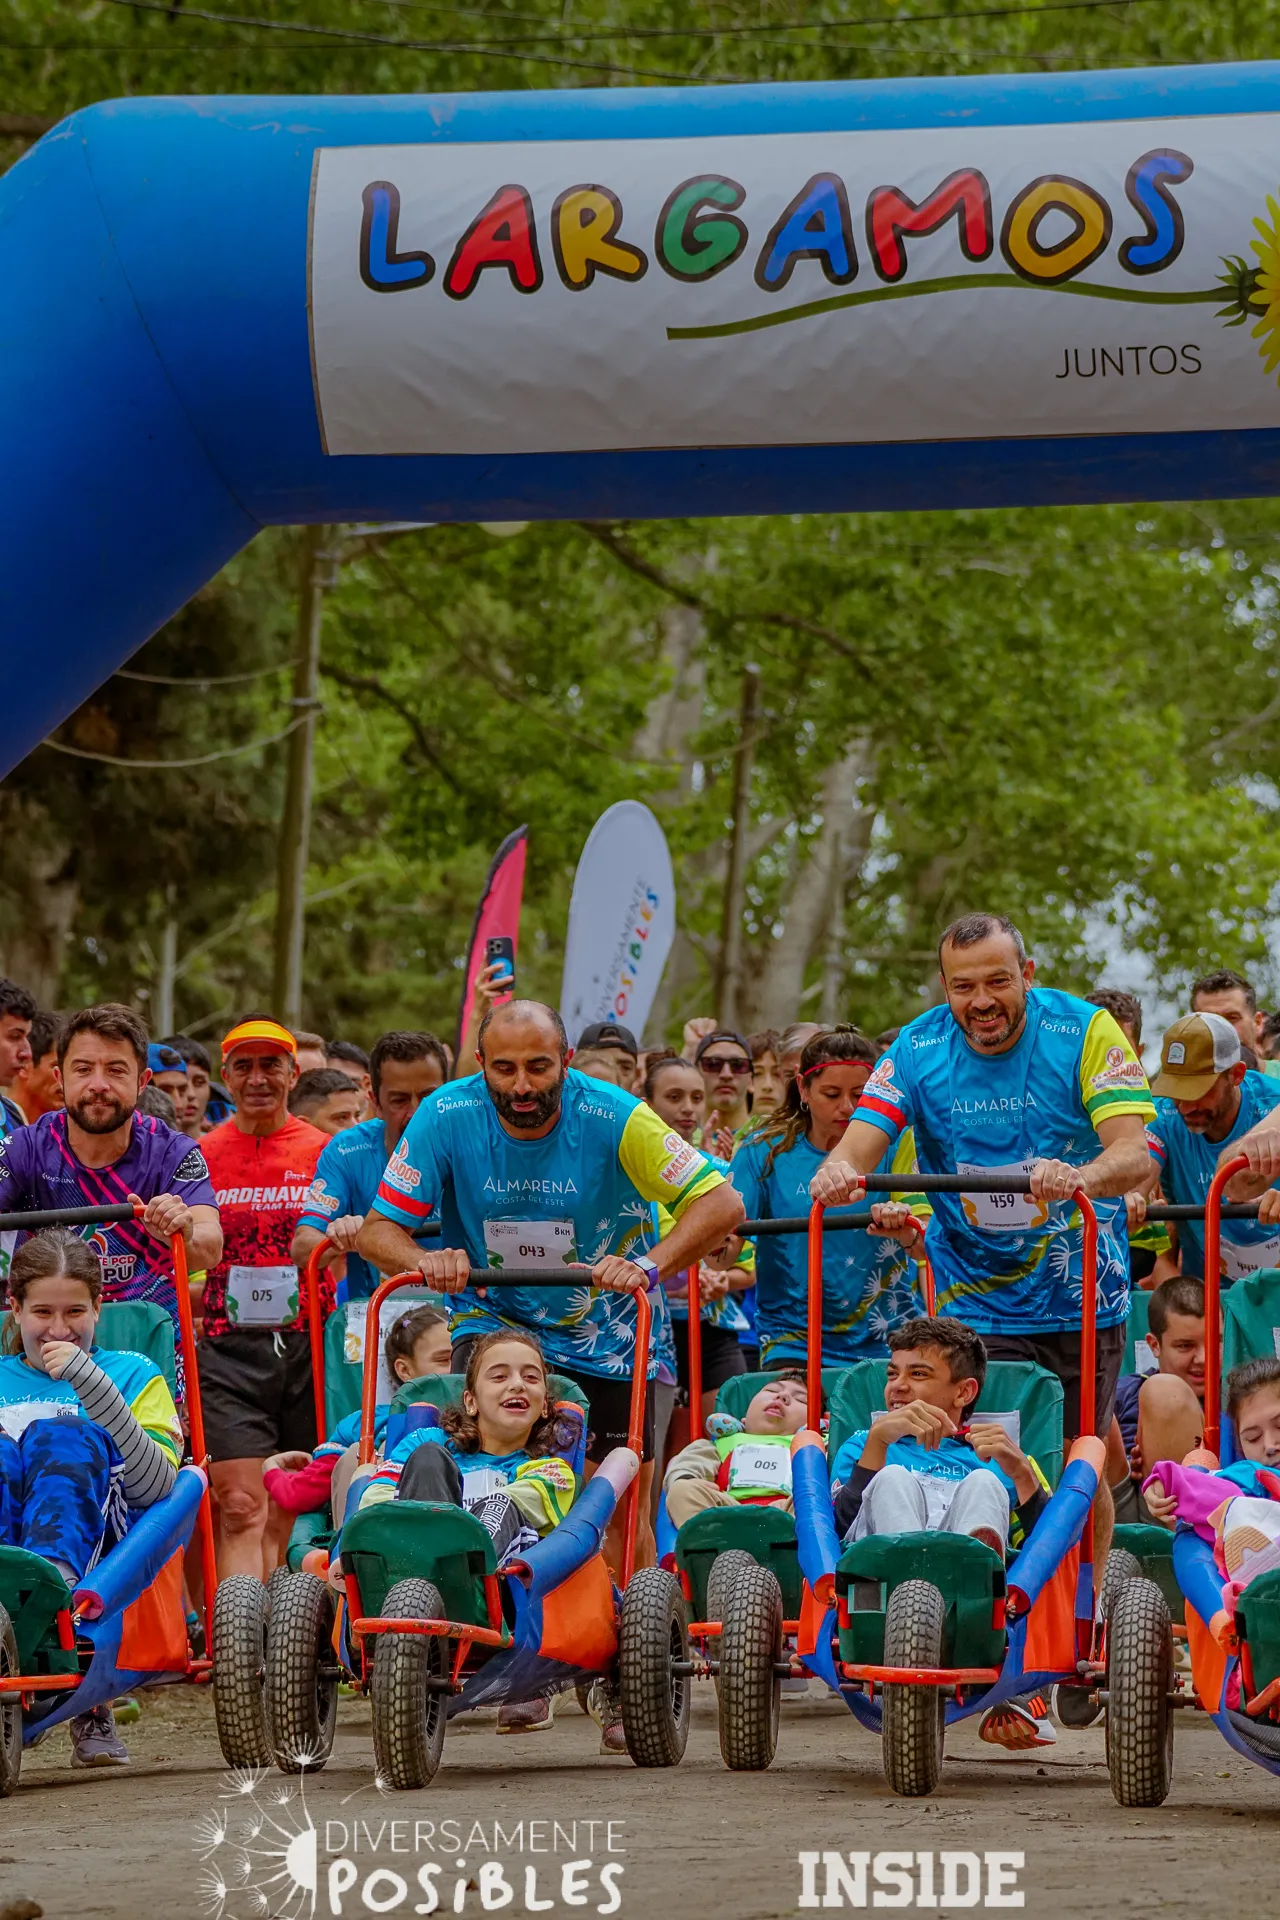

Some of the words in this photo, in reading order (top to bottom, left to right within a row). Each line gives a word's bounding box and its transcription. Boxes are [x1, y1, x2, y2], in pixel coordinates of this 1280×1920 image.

[359, 147, 1194, 300] LARGAMOS
[1055, 343, 1203, 379] JUNTOS
[445, 1099, 484, 1111] MARATÓN
[950, 1091, 1038, 1115] ALMARENA
[963, 1117, 994, 1127] COSTA
[996, 1116, 1012, 1125] DEL
[482, 1175, 578, 1195] ALMARENA
[250, 1202, 284, 1212] TEAM
[284, 1201, 307, 1211] BIK
[495, 1195, 526, 1206] COSTA
[545, 1197, 566, 1208] ESTE
[989, 1193, 1016, 1209] 459
[518, 1245, 546, 1258] 043
[111, 1255, 136, 1266] PCD
[251, 1289, 273, 1302] 075
[754, 1460, 778, 1471] 005
